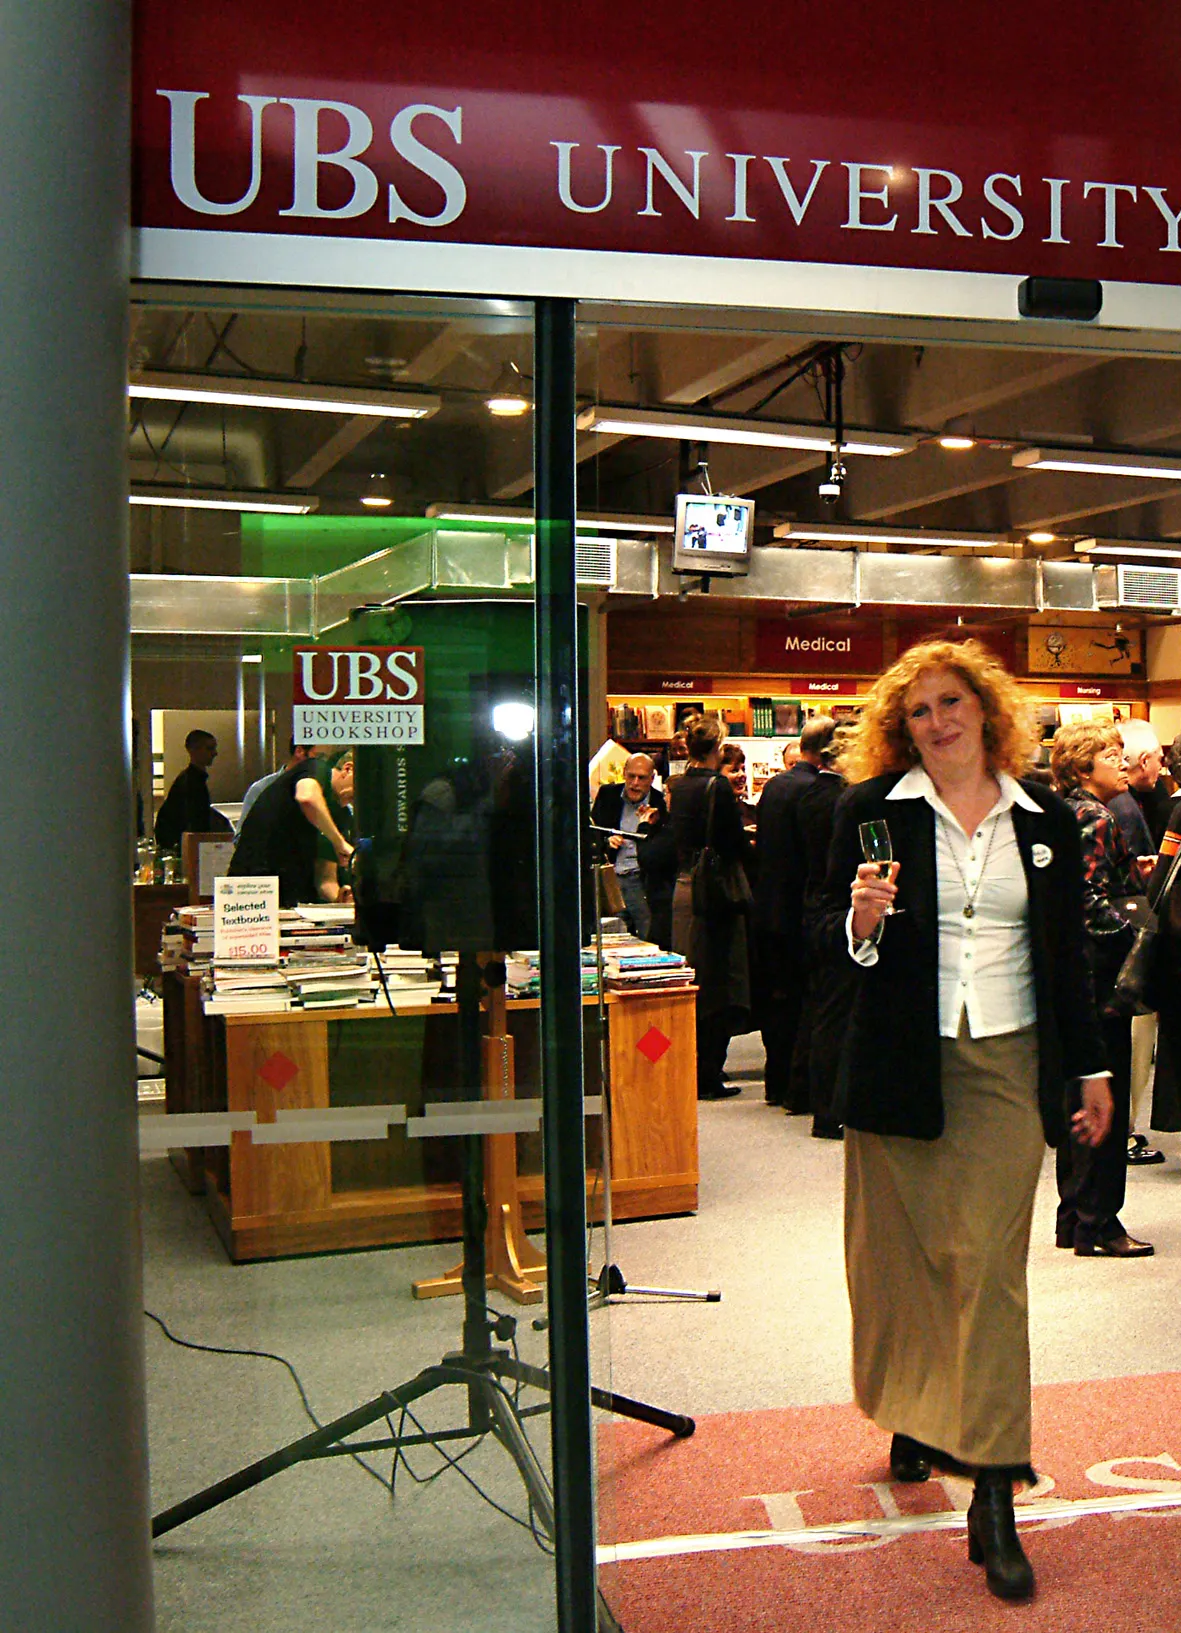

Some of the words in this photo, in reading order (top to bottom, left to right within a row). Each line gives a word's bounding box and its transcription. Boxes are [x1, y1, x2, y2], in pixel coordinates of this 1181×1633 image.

[155, 88, 467, 228] UBS
[785, 635, 852, 653] Medical
[296, 651, 418, 701] UBS
[661, 681, 694, 690] Medical
[808, 682, 840, 692] Medical
[1076, 686, 1101, 696] Nursing
[302, 710, 417, 724] UNIVERSITY
[302, 725, 419, 740] BOOKSHOP
[223, 901, 266, 913] Selected
[221, 915, 270, 926] Textbooks
